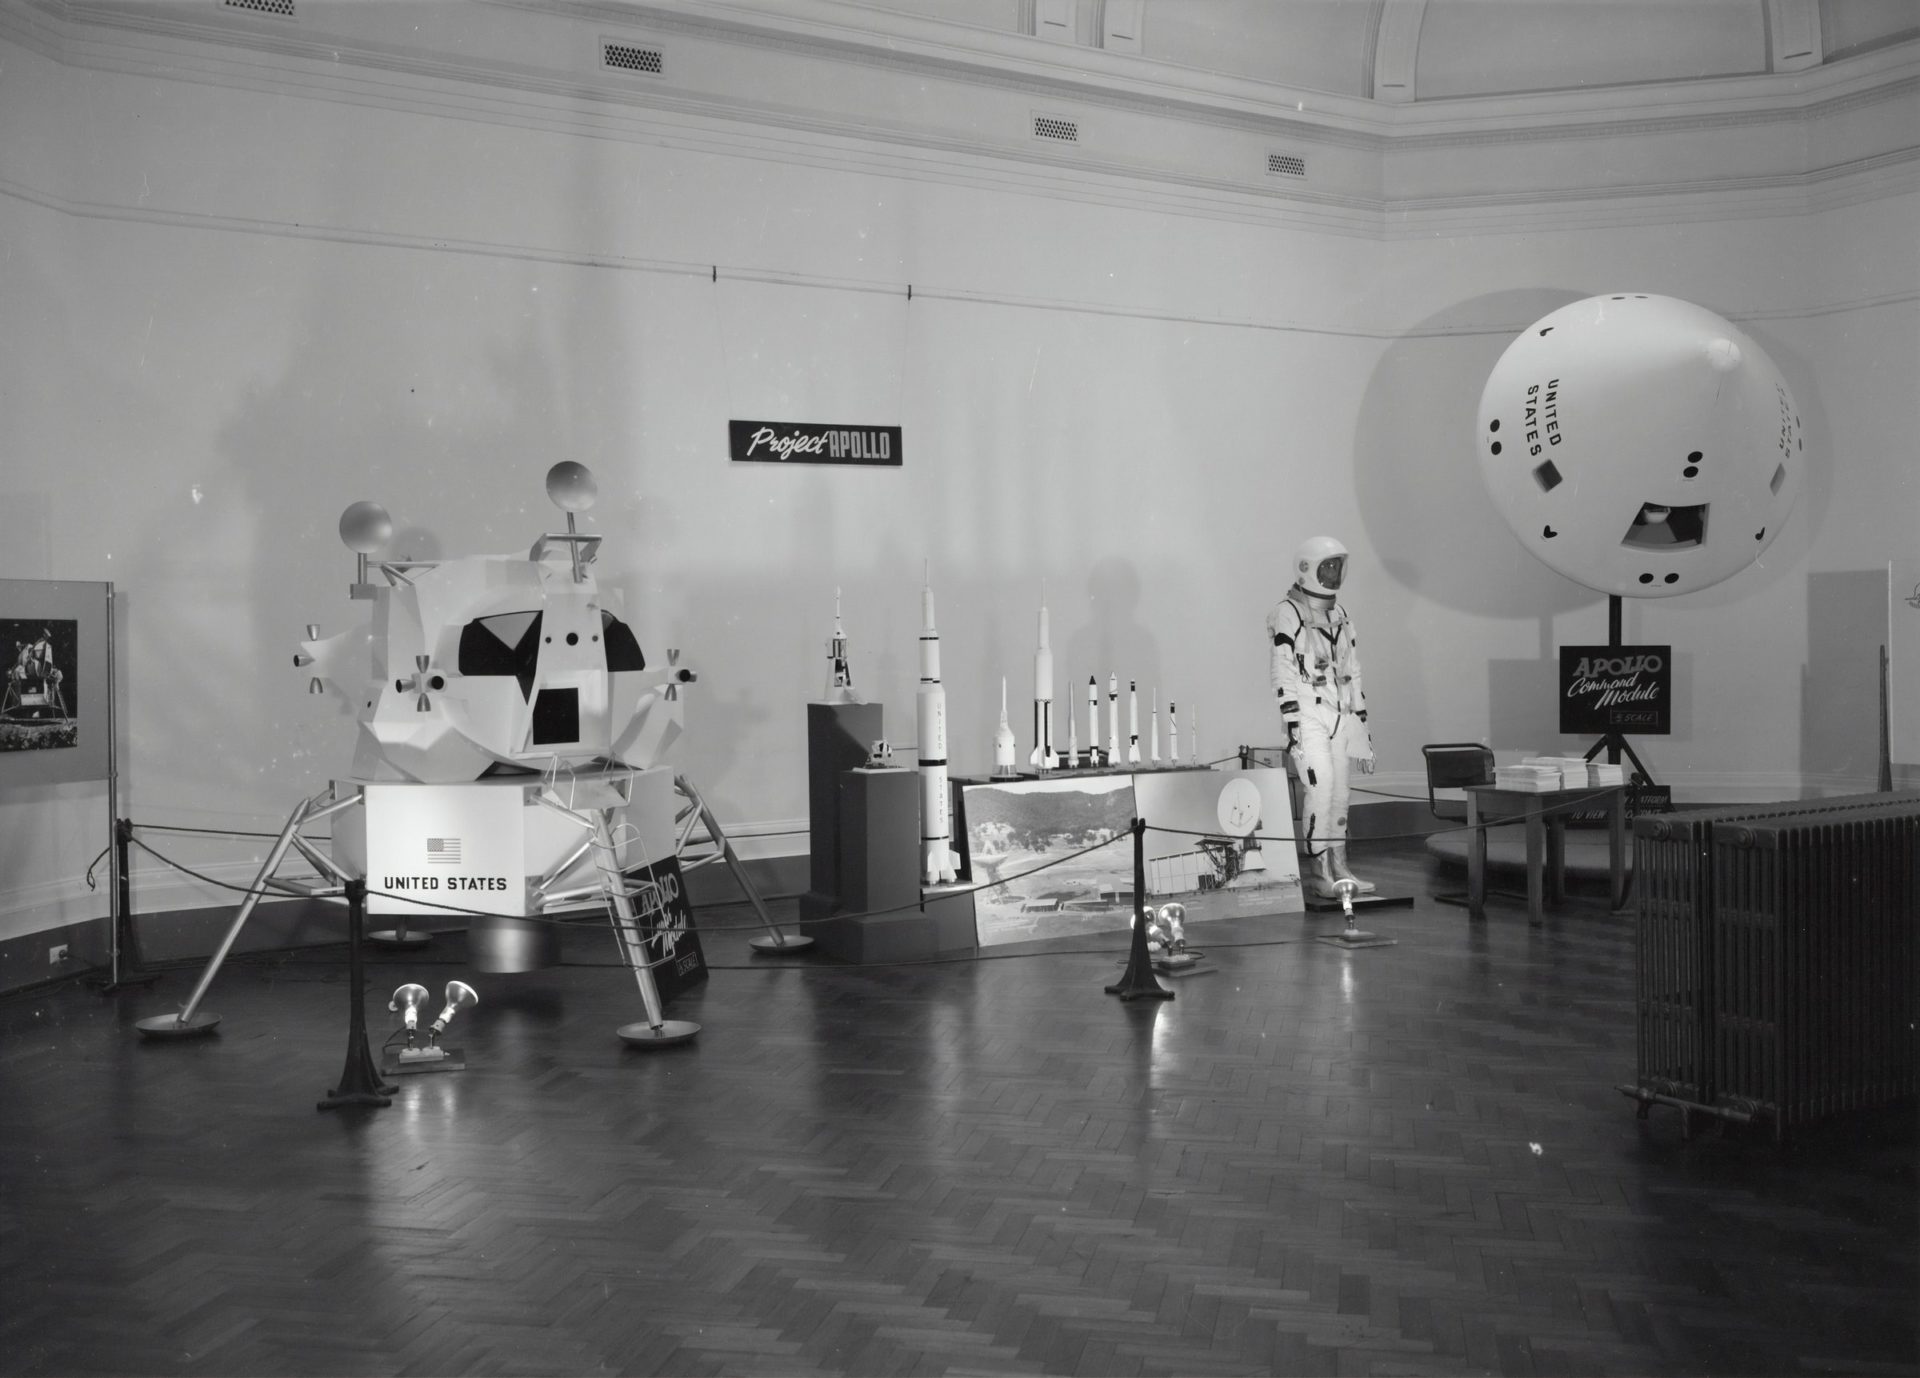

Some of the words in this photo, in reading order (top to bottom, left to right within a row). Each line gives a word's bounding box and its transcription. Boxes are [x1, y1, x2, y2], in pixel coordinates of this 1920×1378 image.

[1524, 384, 1542, 457] STATES
[1544, 378, 1562, 447] UNITED
[747, 426, 829, 460] Project
[829, 430, 890, 459] APOLLO
[1573, 655, 1663, 678] APOLLO
[1567, 672, 1639, 698] Command
[1594, 681, 1660, 710] Module
[384, 876, 439, 890] UNITED
[447, 877, 507, 891] STATES
